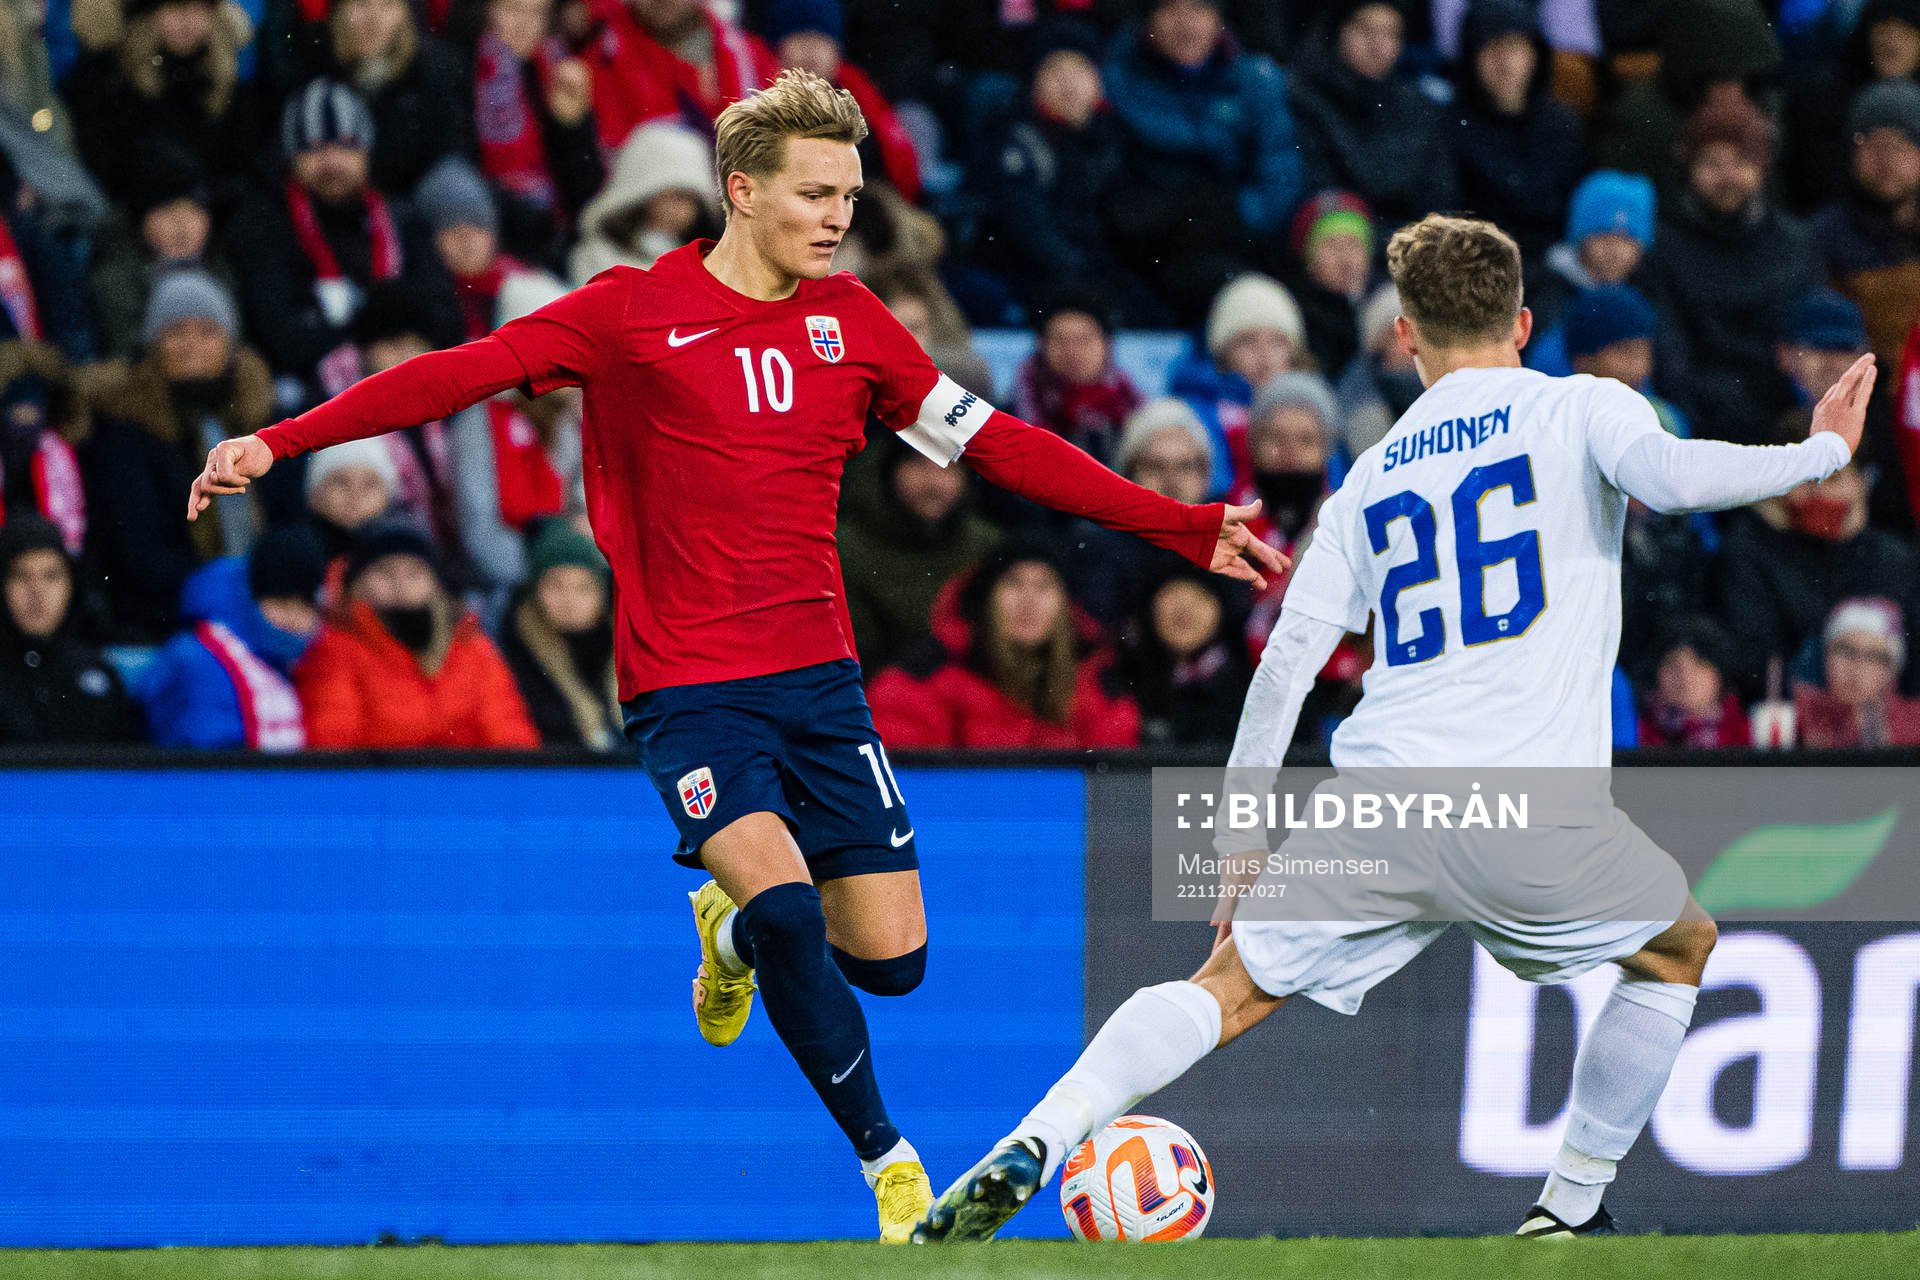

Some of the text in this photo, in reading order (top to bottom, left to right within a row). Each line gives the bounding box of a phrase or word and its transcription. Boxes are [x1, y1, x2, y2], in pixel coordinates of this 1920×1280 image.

[734, 347, 793, 413] 10
[1383, 405, 1511, 473] SUHONEN
[1363, 453, 1548, 667] 26
